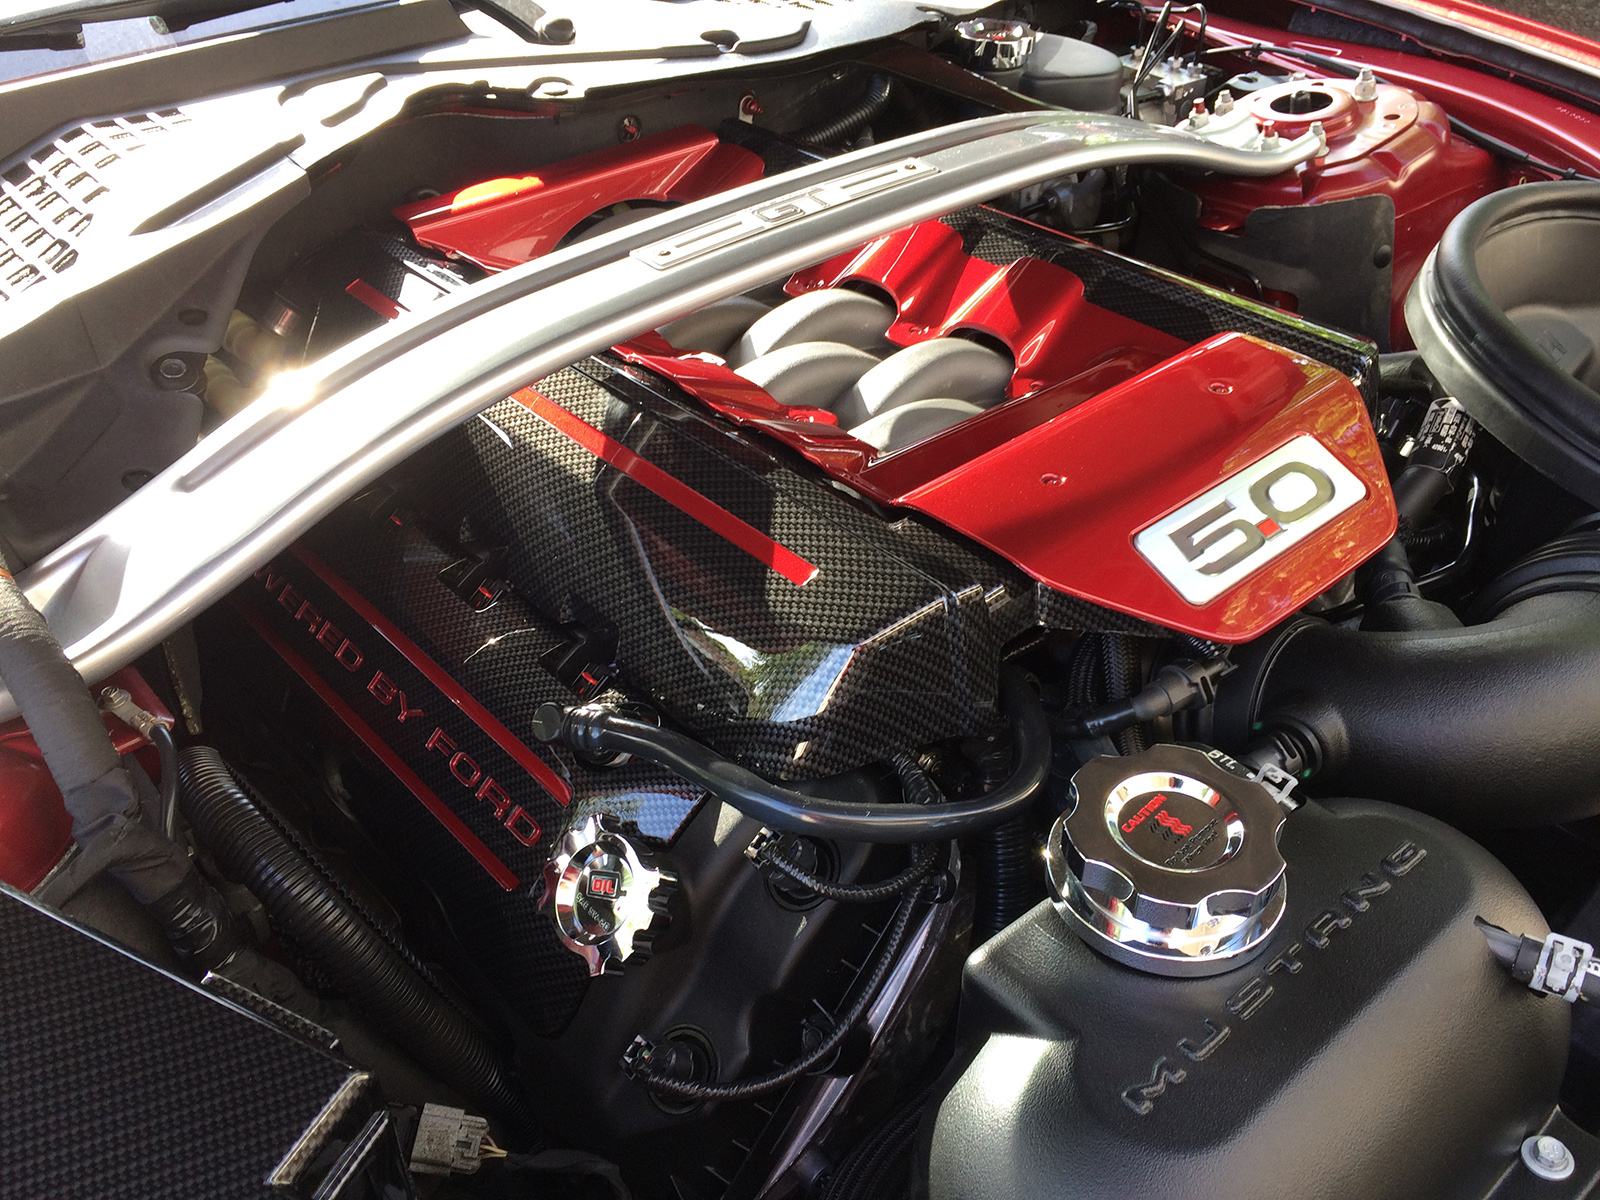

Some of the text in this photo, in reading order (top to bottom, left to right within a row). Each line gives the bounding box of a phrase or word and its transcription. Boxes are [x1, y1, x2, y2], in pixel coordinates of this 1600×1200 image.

[751, 186, 831, 224] GT
[1167, 460, 1337, 578] 5.0
[253, 565, 542, 847] WERED BY FORD
[1121, 793, 1168, 833] CAUTION
[591, 878, 616, 894] OIL
[1120, 839, 1428, 1116] MUSTANG
